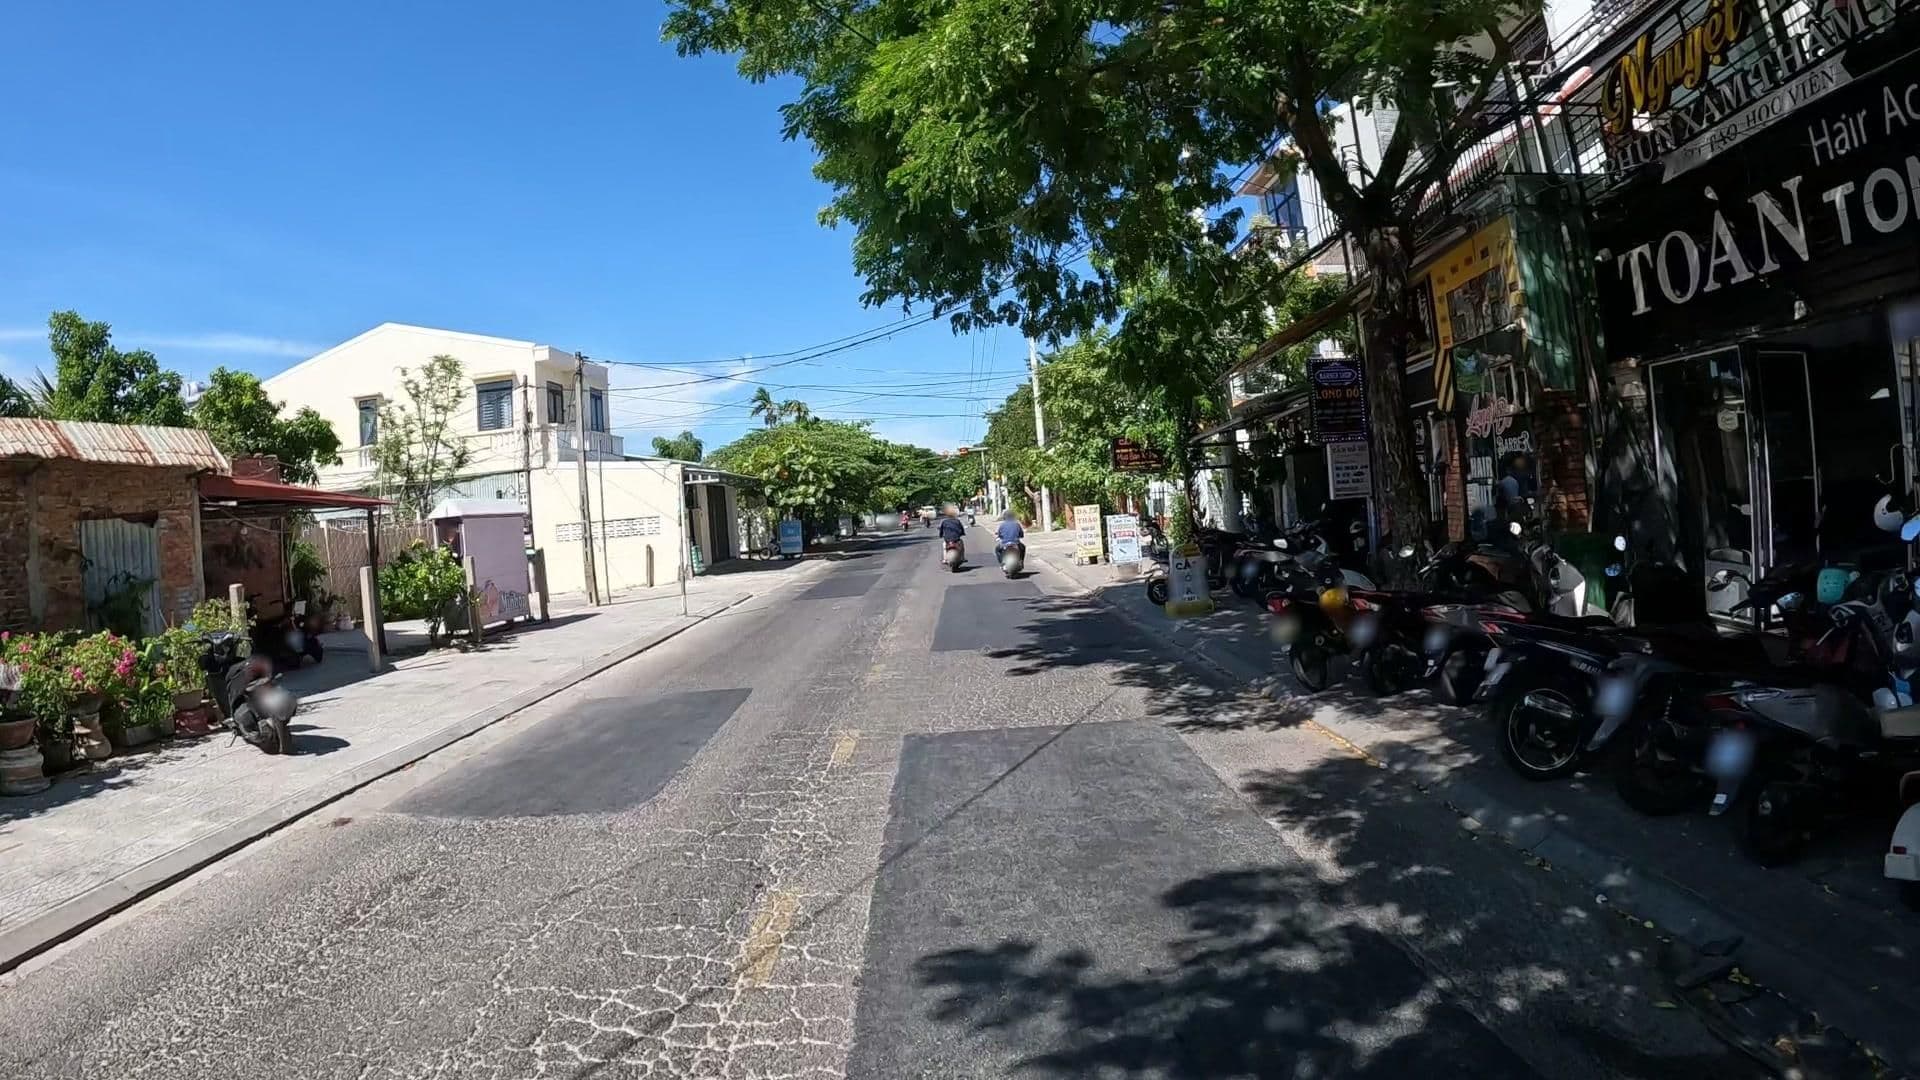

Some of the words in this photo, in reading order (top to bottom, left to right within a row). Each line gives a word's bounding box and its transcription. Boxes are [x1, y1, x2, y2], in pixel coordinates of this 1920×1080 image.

[1807, 107, 1868, 168] Hair
[1616, 174, 1809, 317] TOÀN
[1470, 456, 1493, 479] HAIR
